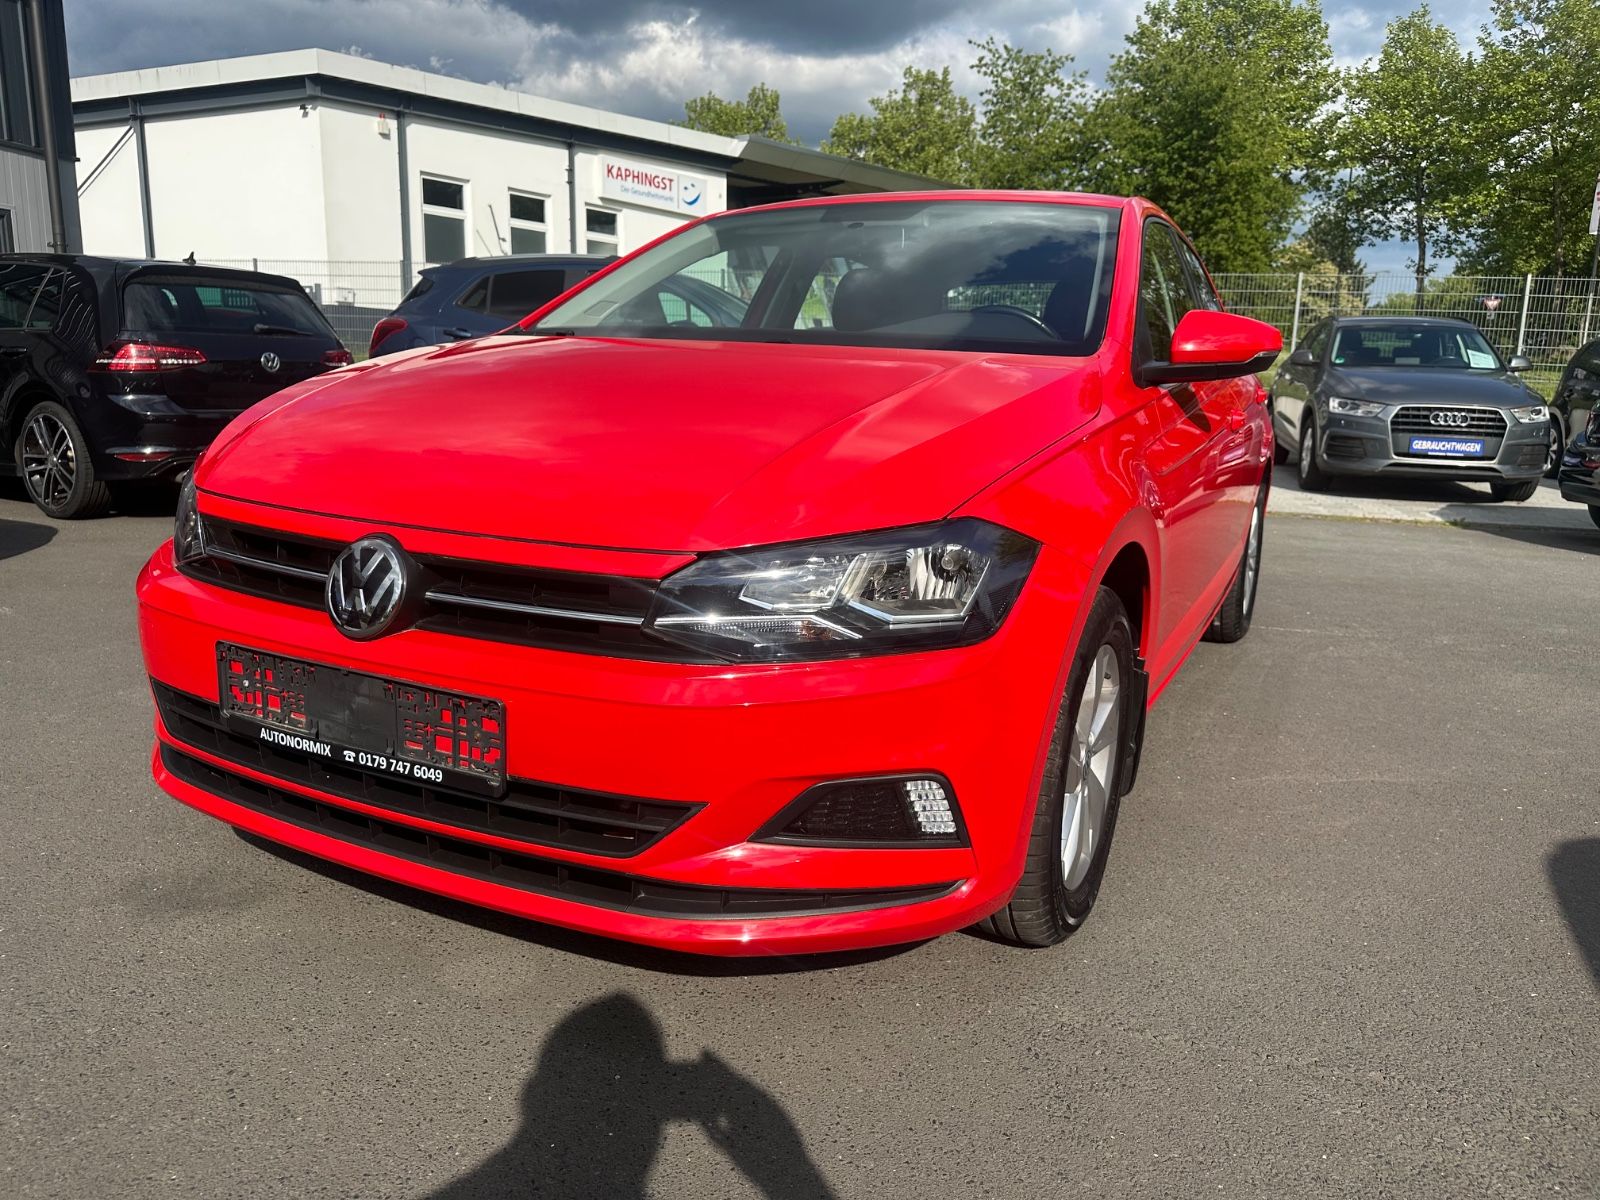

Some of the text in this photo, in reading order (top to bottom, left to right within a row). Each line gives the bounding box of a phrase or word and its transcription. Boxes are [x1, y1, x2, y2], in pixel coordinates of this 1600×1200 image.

[606, 164, 674, 192] KAPHINGST
[1412, 440, 1481, 452] GEBRAUCHTWAGEN
[260, 727, 443, 783] AUTONORMIX 0179 747 6049
